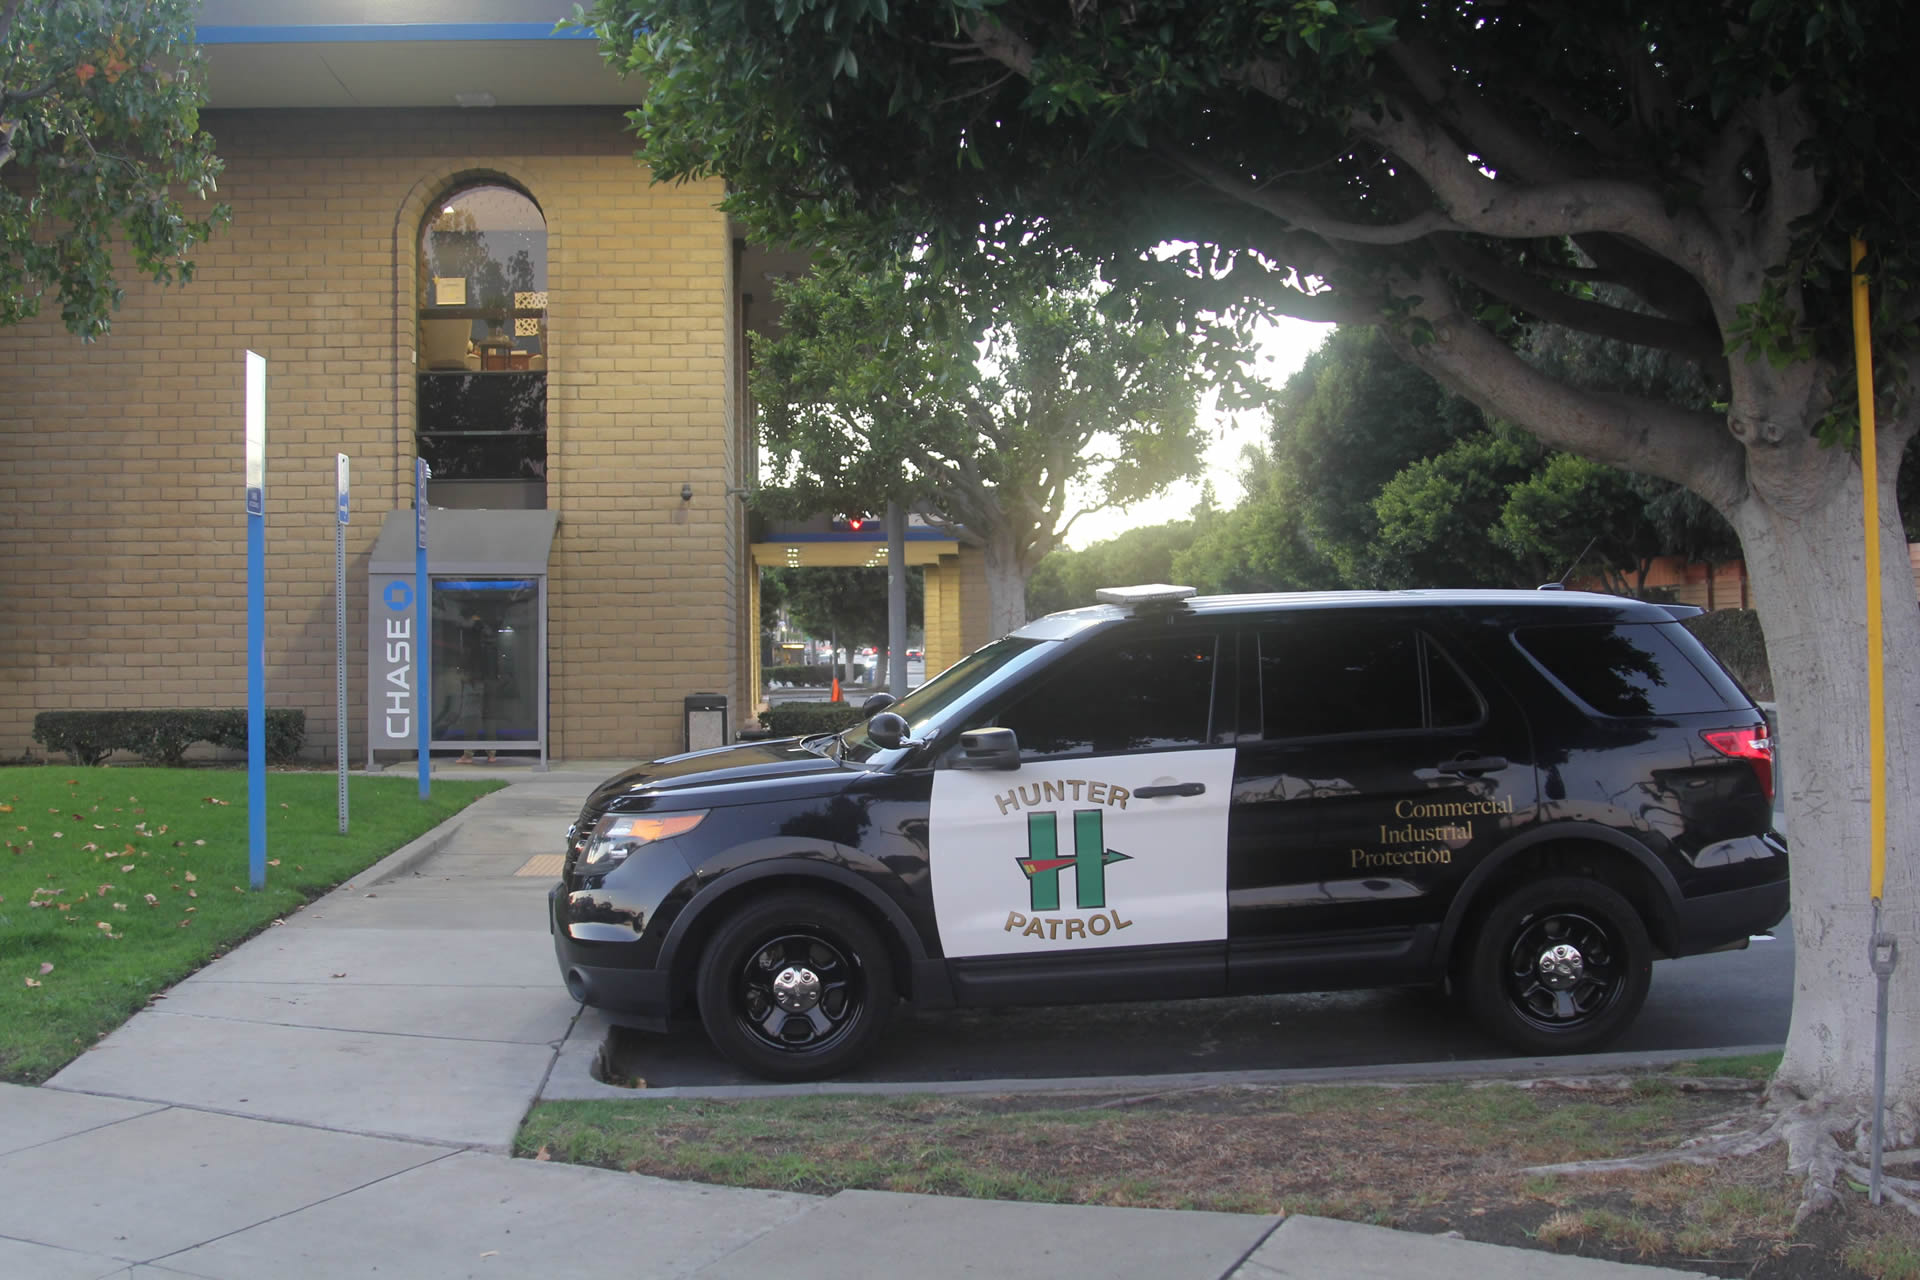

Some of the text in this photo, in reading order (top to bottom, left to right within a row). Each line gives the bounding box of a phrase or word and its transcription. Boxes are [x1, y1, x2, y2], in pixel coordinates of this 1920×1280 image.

[386, 618, 411, 738] CHASE
[994, 779, 1131, 815] HUNTER
[1395, 795, 1513, 819] Commercial
[1379, 821, 1474, 844] Industrial
[1351, 846, 1451, 868] Protection
[1004, 909, 1133, 939] PATROL
